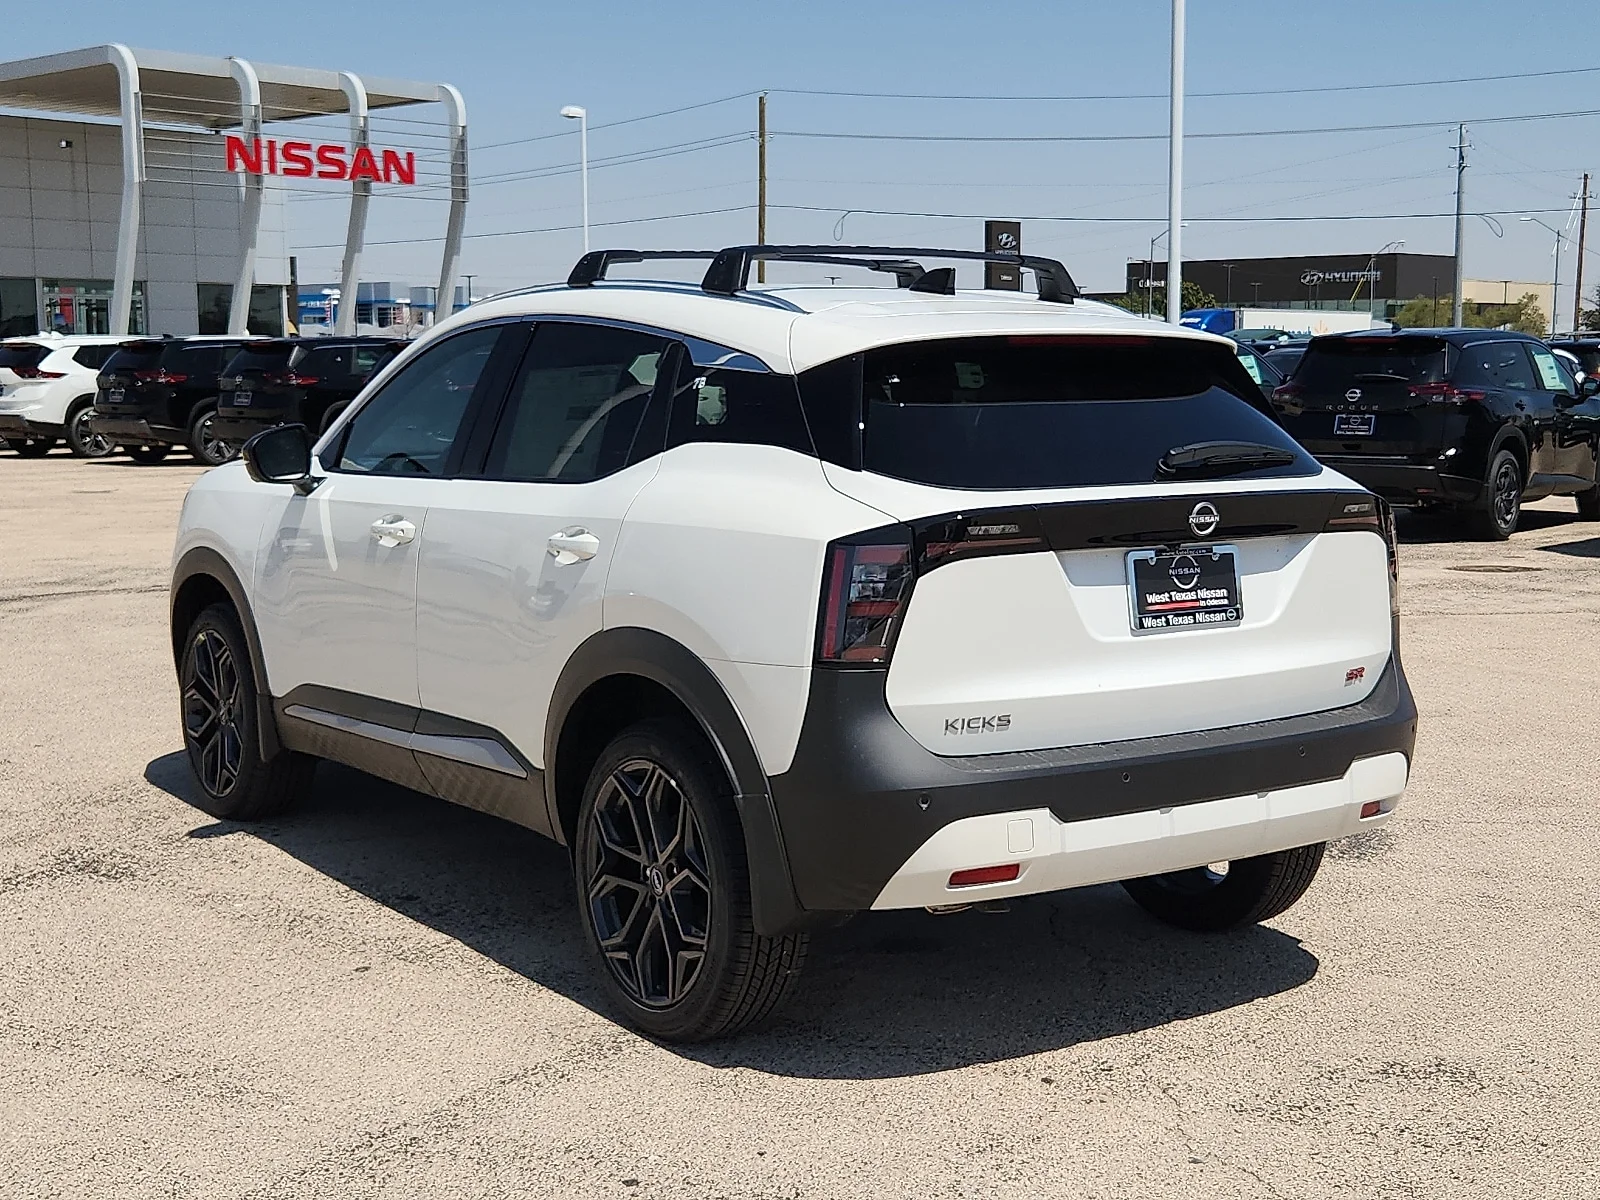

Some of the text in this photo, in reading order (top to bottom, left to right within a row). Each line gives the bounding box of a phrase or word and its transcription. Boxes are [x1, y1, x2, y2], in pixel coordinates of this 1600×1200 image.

[225, 135, 415, 185] NISSAN
[1188, 514, 1220, 524] NISSAN
[1168, 567, 1200, 576] NISSAN
[1145, 588, 1228, 604] West Texas Nissan
[1142, 612, 1227, 629] West Texas Nissan
[944, 714, 1012, 732] KICKS
